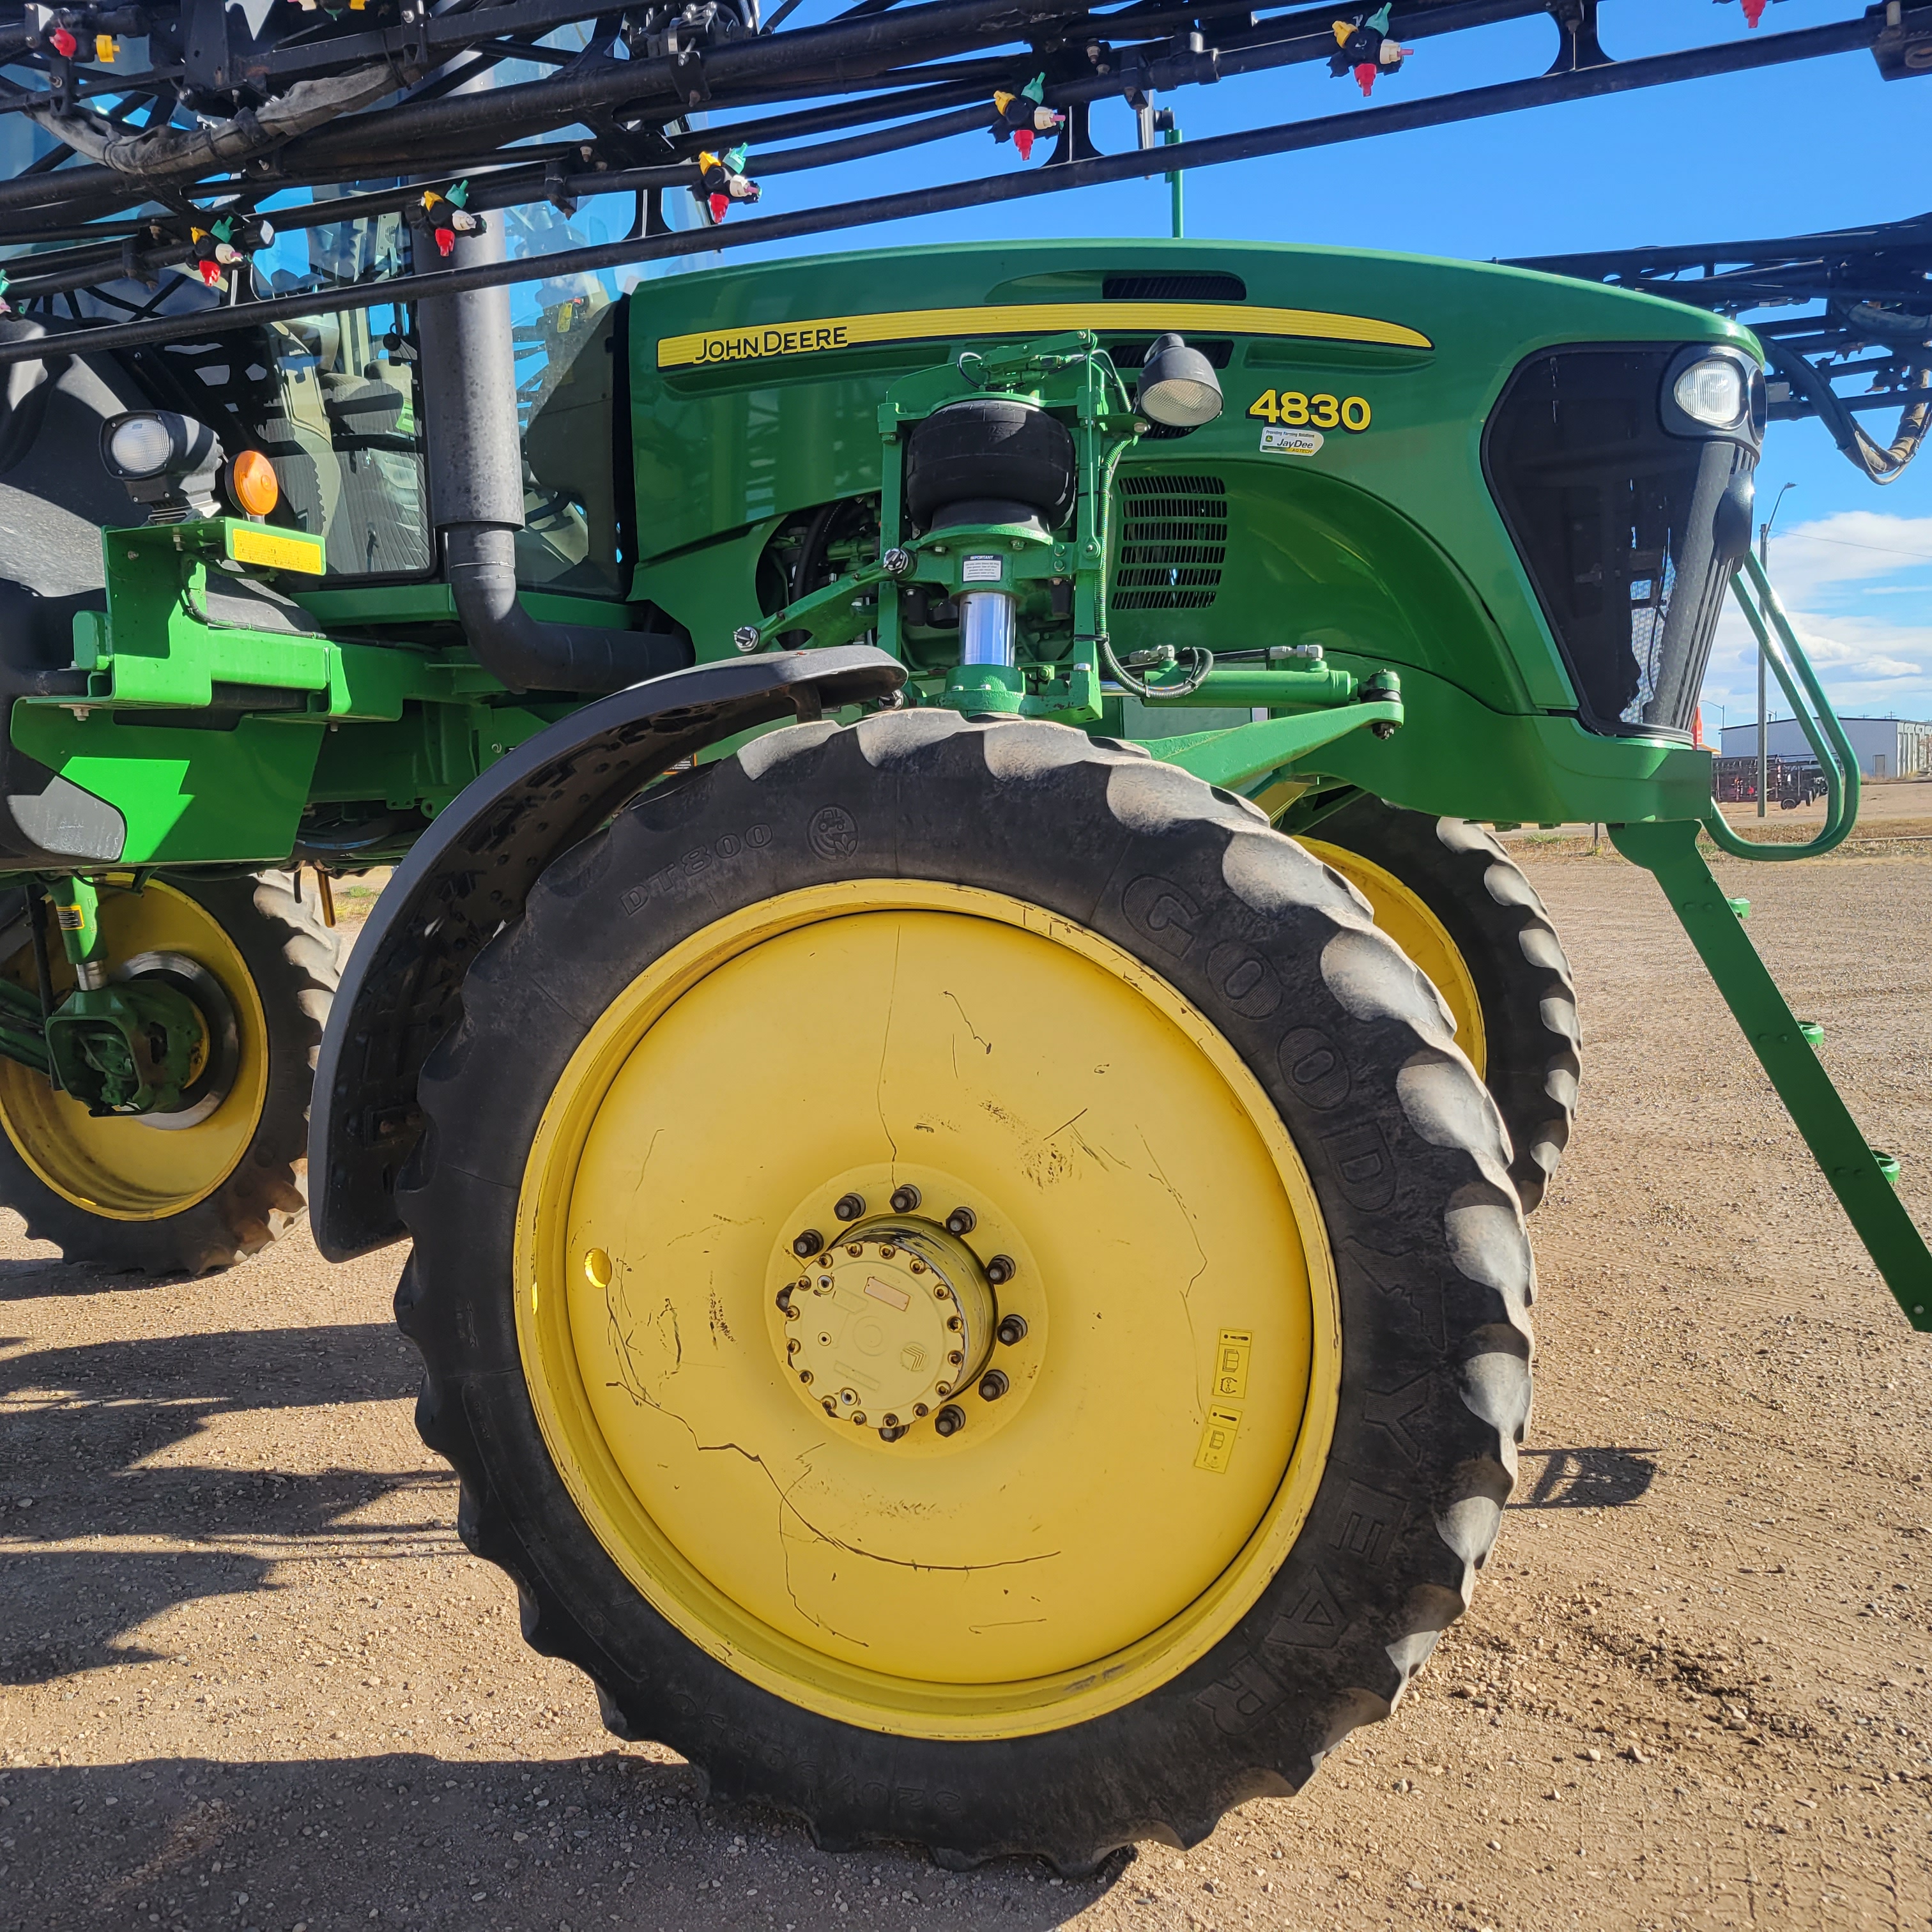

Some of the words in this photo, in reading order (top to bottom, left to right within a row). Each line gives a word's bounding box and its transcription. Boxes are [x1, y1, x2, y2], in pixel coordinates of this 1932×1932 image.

[694, 337, 759, 362] JOHN
[763, 326, 848, 353] DEERE
[1248, 388, 1372, 433] 4830
[1276, 438, 1313, 448] JayDee
[620, 823, 772, 916] DT800
